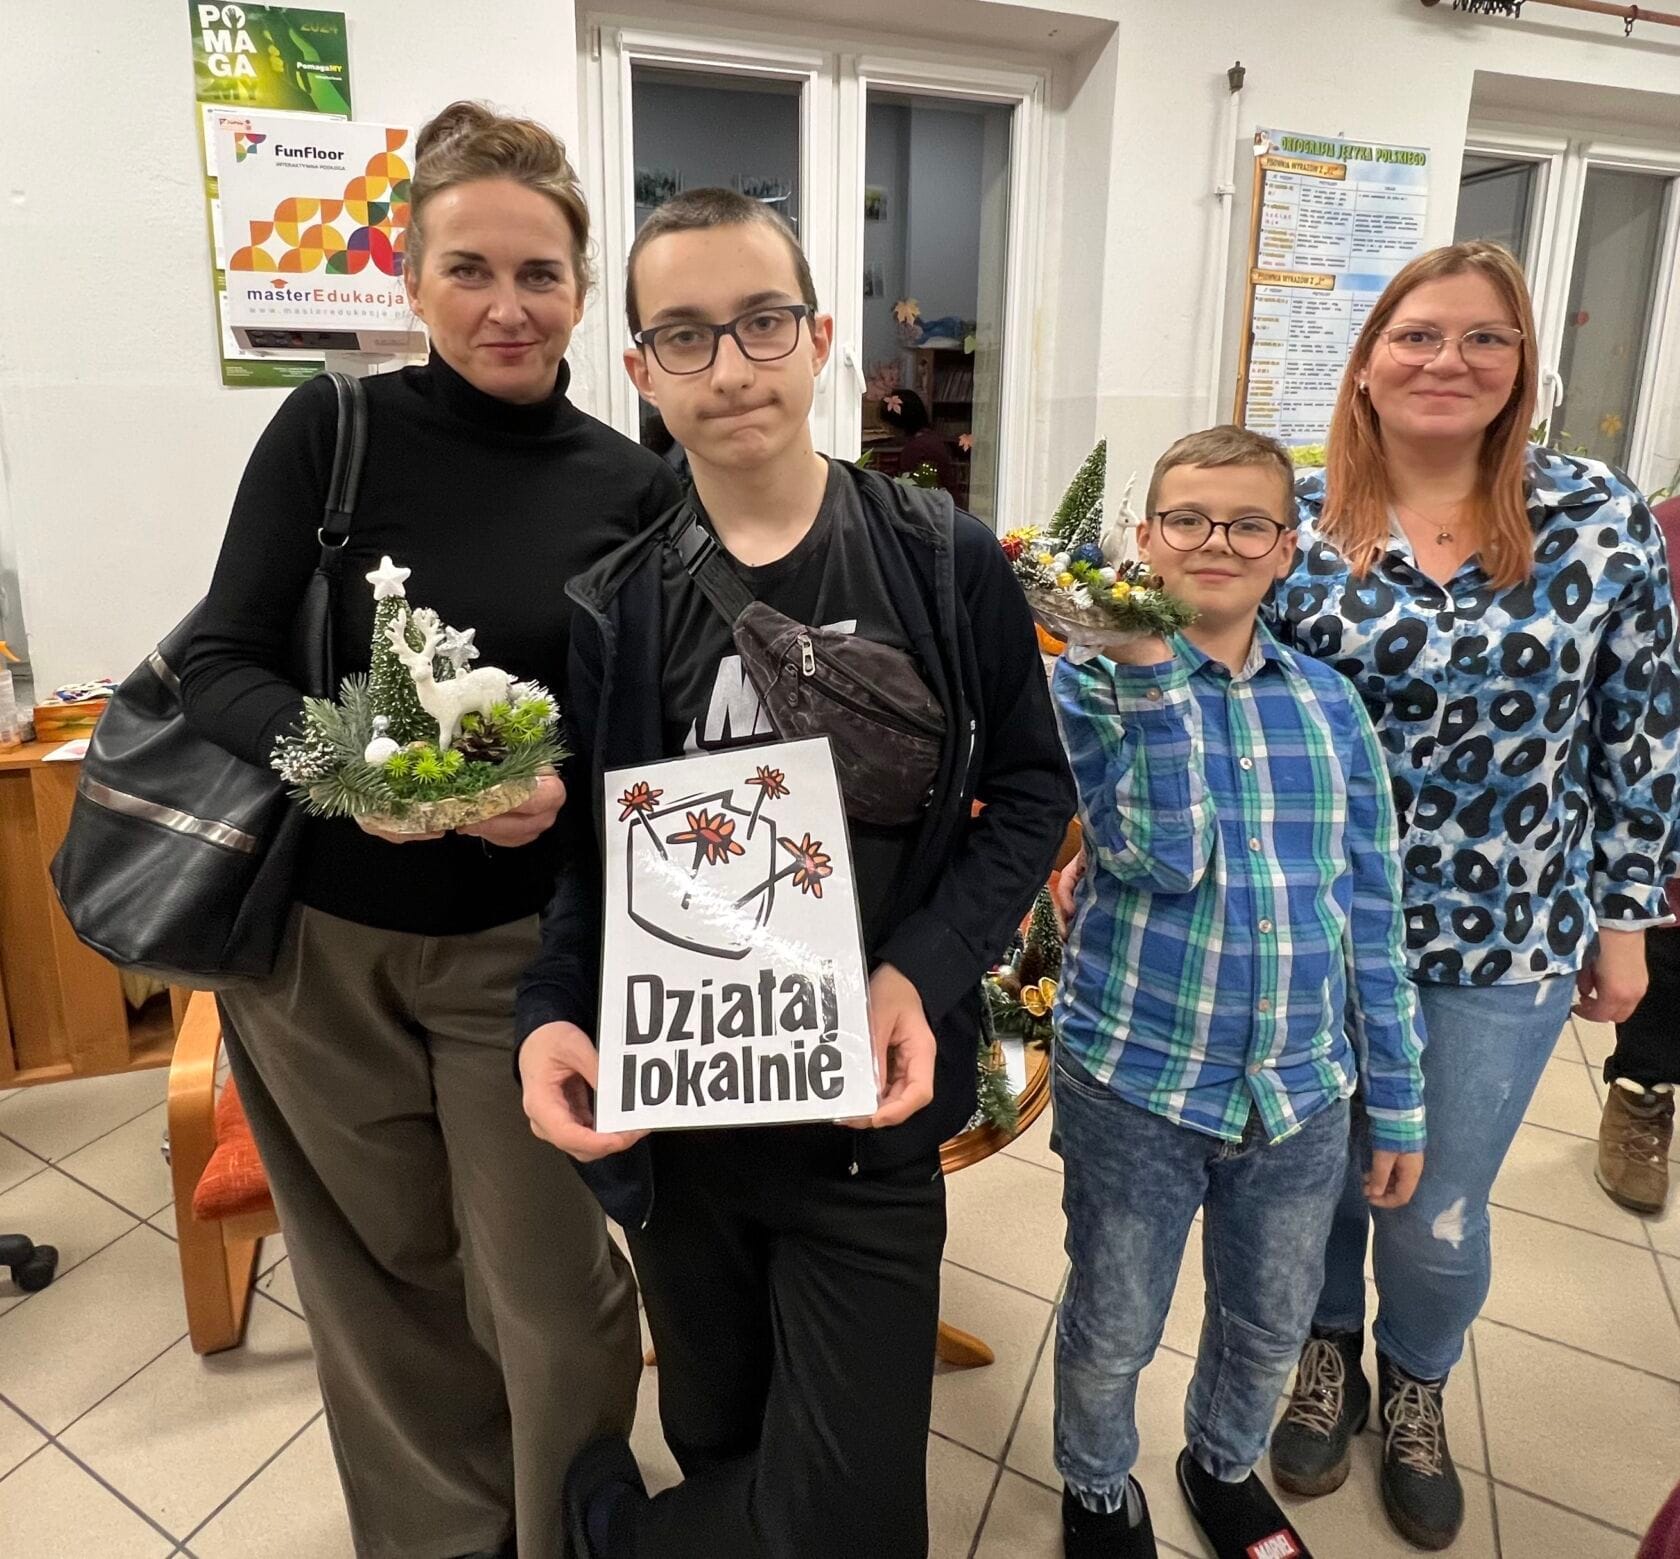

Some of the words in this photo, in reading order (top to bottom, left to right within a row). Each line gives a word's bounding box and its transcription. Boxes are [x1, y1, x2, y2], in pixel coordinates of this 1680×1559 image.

[202, 29, 257, 54] MA
[207, 53, 257, 78] GA
[274, 144, 345, 161] FunFloor
[1375, 147, 1427, 167] POLSKIEGO
[247, 287, 404, 307] masterEdukacja
[625, 959, 839, 1045] Działaj
[621, 1040, 844, 1112] lokalnie
